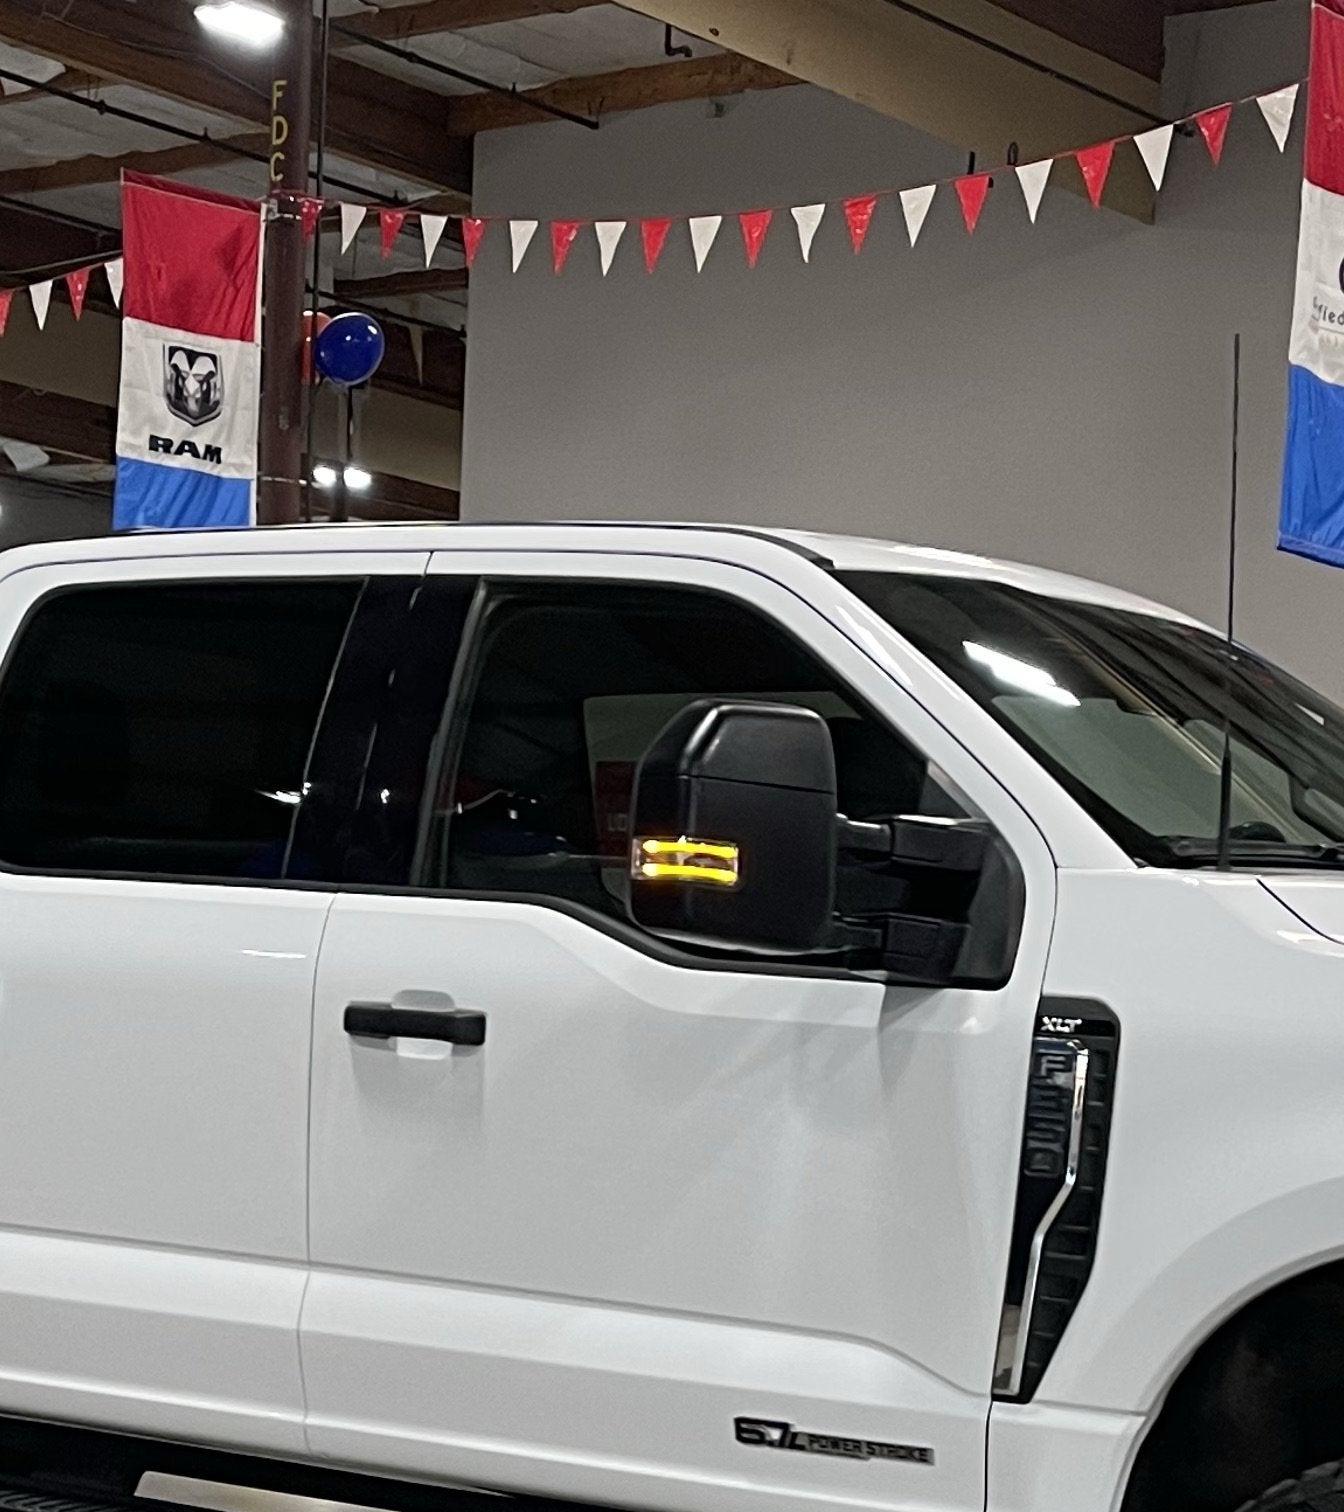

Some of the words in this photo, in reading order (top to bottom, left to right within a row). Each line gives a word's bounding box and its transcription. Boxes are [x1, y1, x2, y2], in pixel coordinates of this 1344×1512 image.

[148, 433, 222, 464] RAM
[1040, 1015, 1083, 1033] XLT
[807, 1433, 863, 1456] POWER
[864, 1440, 930, 1464] STROKE
